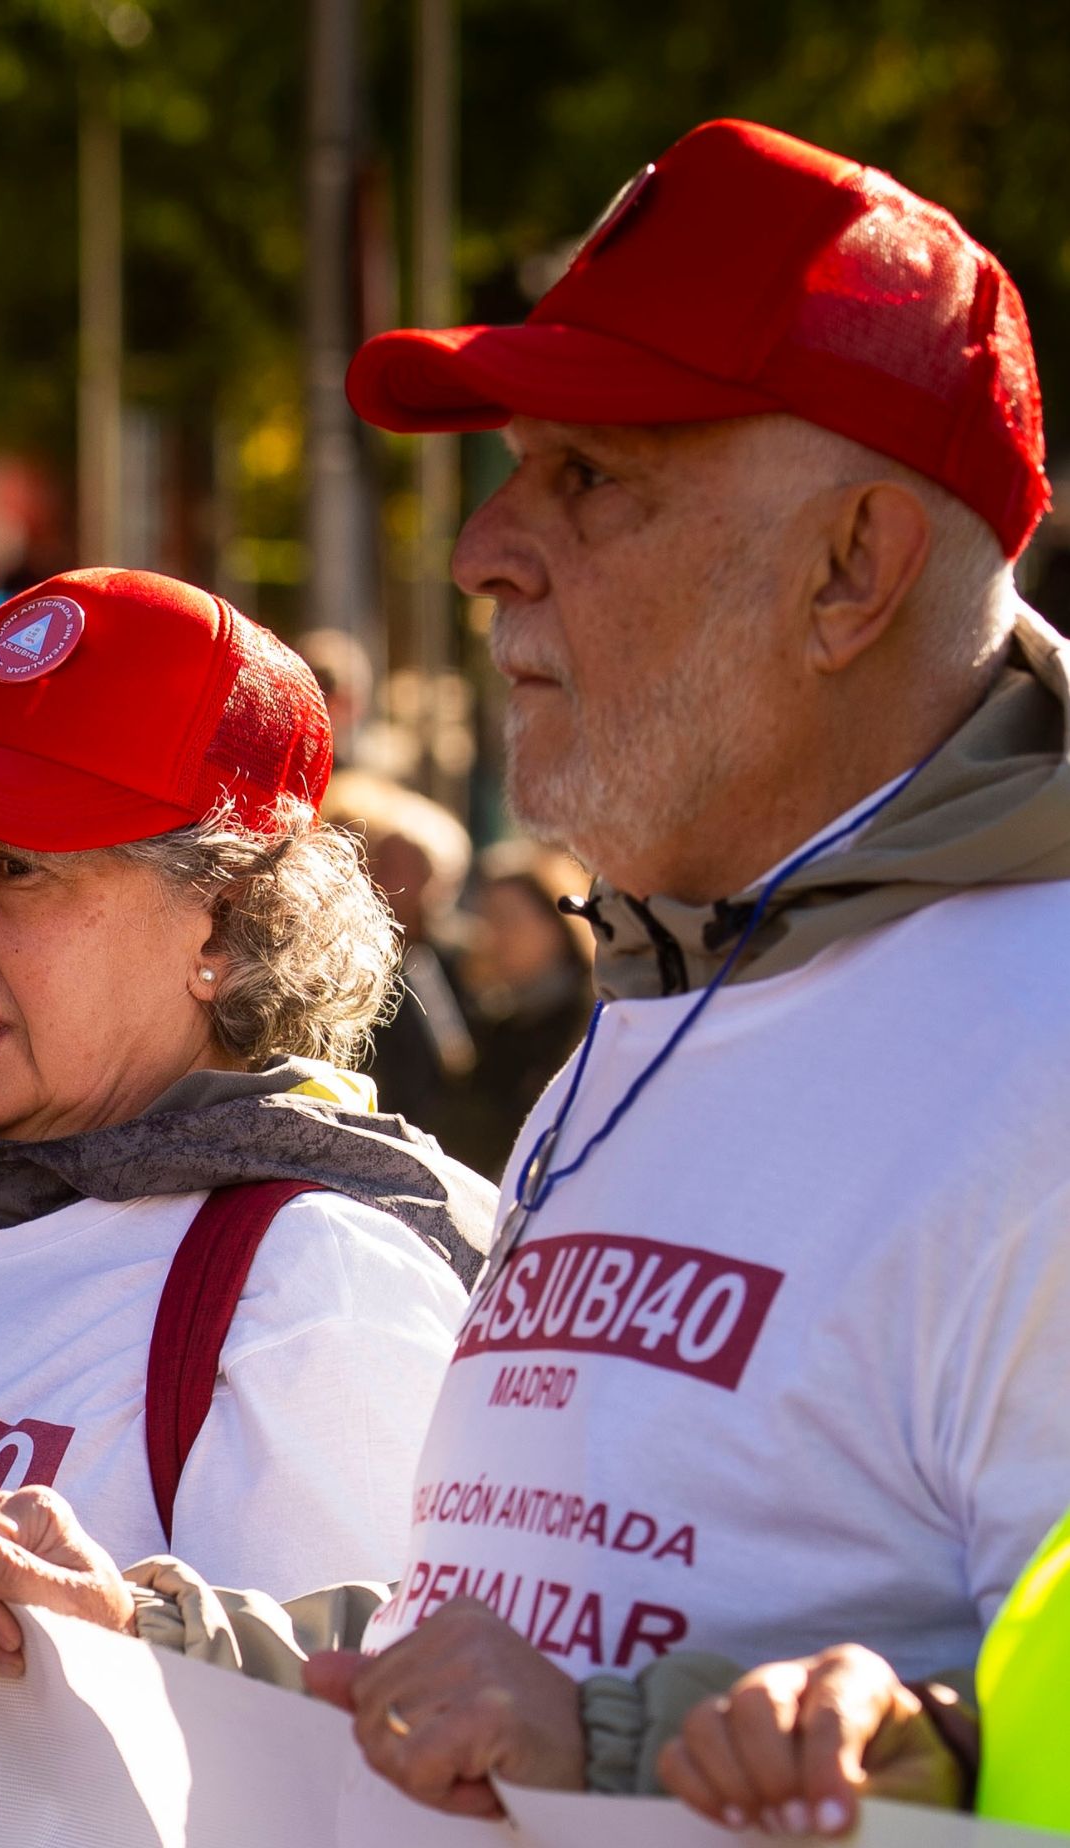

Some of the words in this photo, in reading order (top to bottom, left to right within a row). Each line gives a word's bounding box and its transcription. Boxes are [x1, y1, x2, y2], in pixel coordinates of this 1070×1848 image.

[20, 600, 73, 620] ANTICIPADA
[62, 622, 74, 640] SIN
[0, 640, 39, 661] ASJUBI40
[6, 642, 65, 673] PENALIZAR
[487, 1366, 577, 1410] MADRID
[493, 1485, 697, 1568] ANTICIPADA
